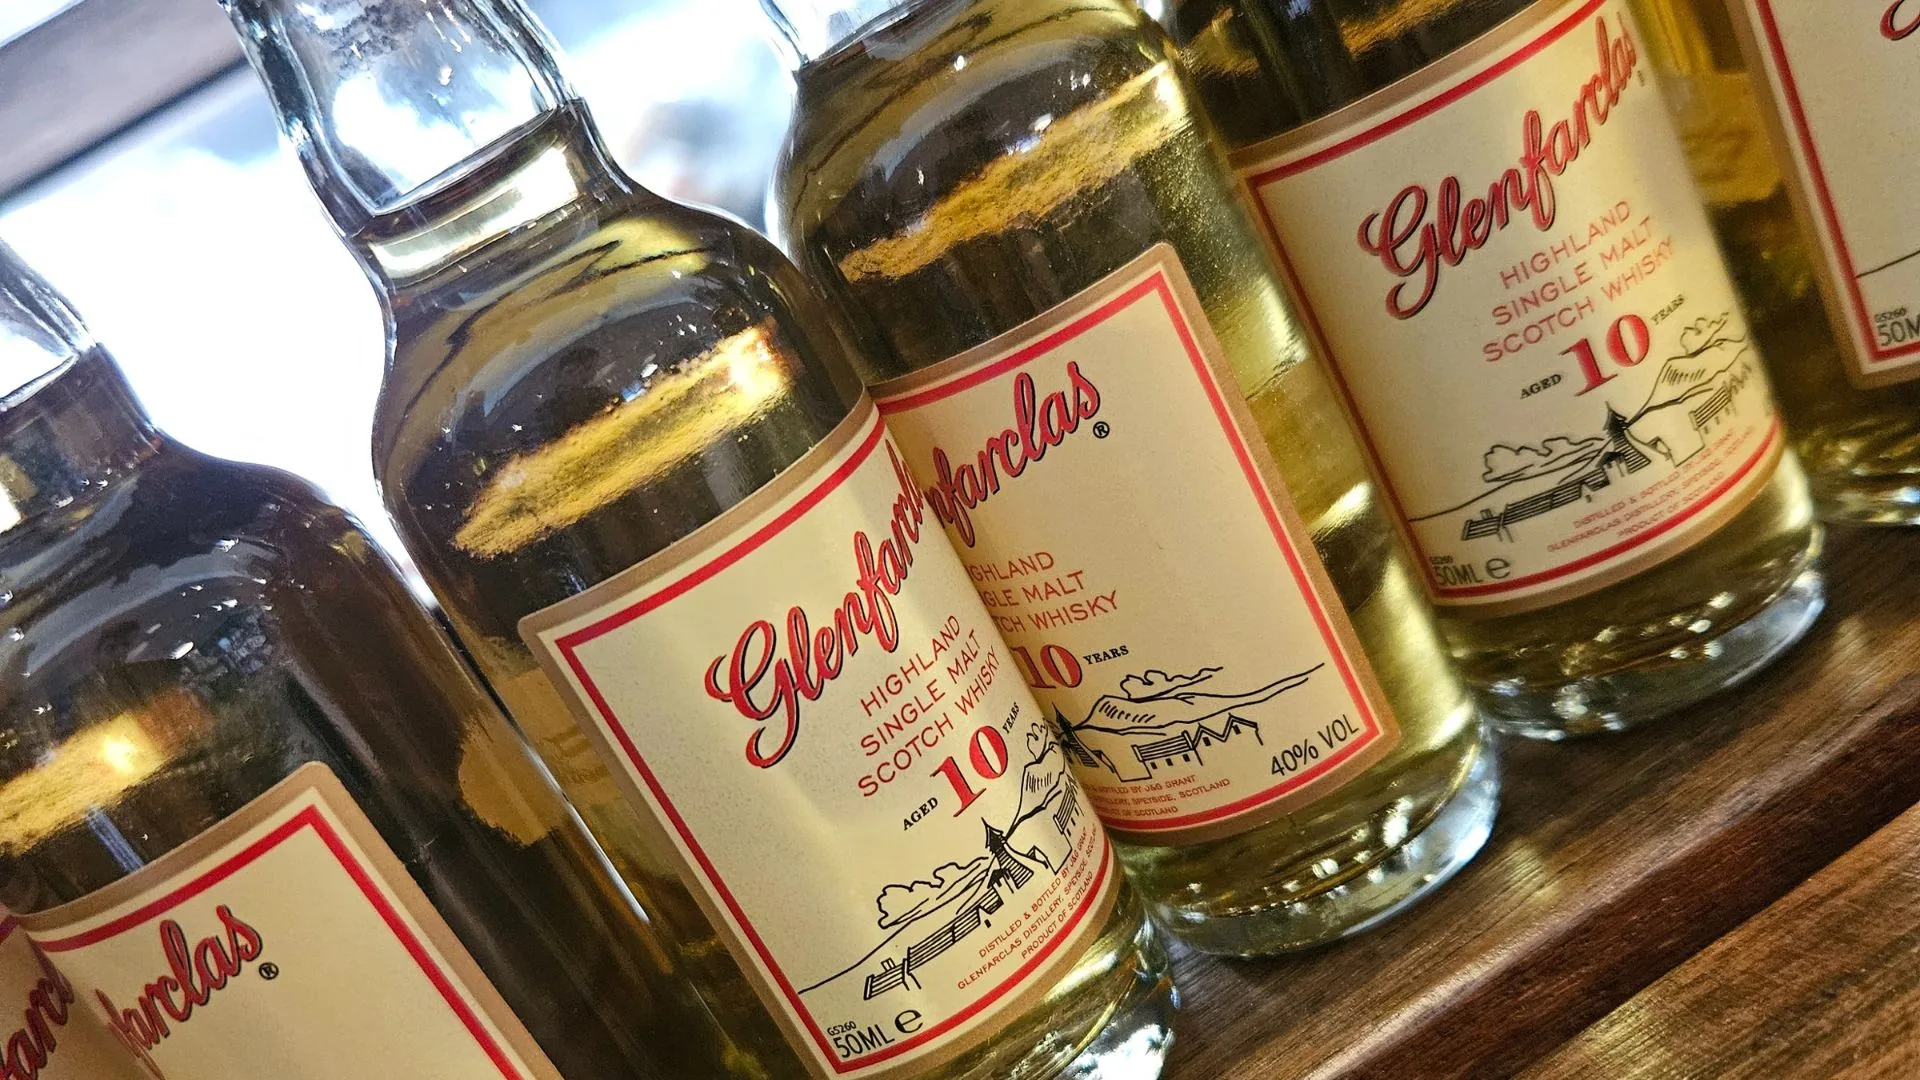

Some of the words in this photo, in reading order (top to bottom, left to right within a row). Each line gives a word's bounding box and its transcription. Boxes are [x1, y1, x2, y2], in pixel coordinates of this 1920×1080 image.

[1491, 261, 1593, 326] SINGLE
[1599, 216, 1654, 270] MALT
[1500, 200, 1631, 289] HIGHLAND
[1482, 296, 1595, 362] SCOTCH
[1600, 235, 1675, 301] WHISKY
[1877, 314, 1920, 346] 50M
[1519, 373, 1563, 399] AGED
[1558, 314, 1650, 397] 10
[922, 361, 1101, 548] nfarclas
[704, 439, 924, 769] Glenfarcl
[1021, 570, 1086, 603] MALT
[1028, 590, 1118, 630] WHISKY
[1434, 563, 1484, 586] 50ML
[860, 615, 961, 717] HIGHLAND
[860, 678, 945, 756] SINGLE
[946, 629, 981, 684] MALT
[1008, 644, 1083, 689] 10
[1083, 645, 1129, 666] YEARS
[858, 712, 954, 797] SCOTCH
[954, 645, 1000, 716] WHISKY
[1269, 738, 1320, 778] 40%
[1317, 713, 1360, 750] VOL
[902, 797, 940, 831] AGED
[930, 725, 1009, 818] 10
[1002, 702, 1020, 735] YEARS
[1178, 778, 1231, 799] SCOTLAND
[979, 919, 1022, 958] DISTILLED
[1023, 911, 1032, 920] &
[1031, 877, 1062, 912] BOTTLED
[1060, 866, 1070, 879] BY
[1021, 921, 1059, 960] PRODUCT
[1057, 909, 1068, 923] OF
[1067, 871, 1094, 911] SCOTLAND
[957, 939, 1023, 990] GLENFARCLAS
[834, 1023, 895, 1059] 50ML
